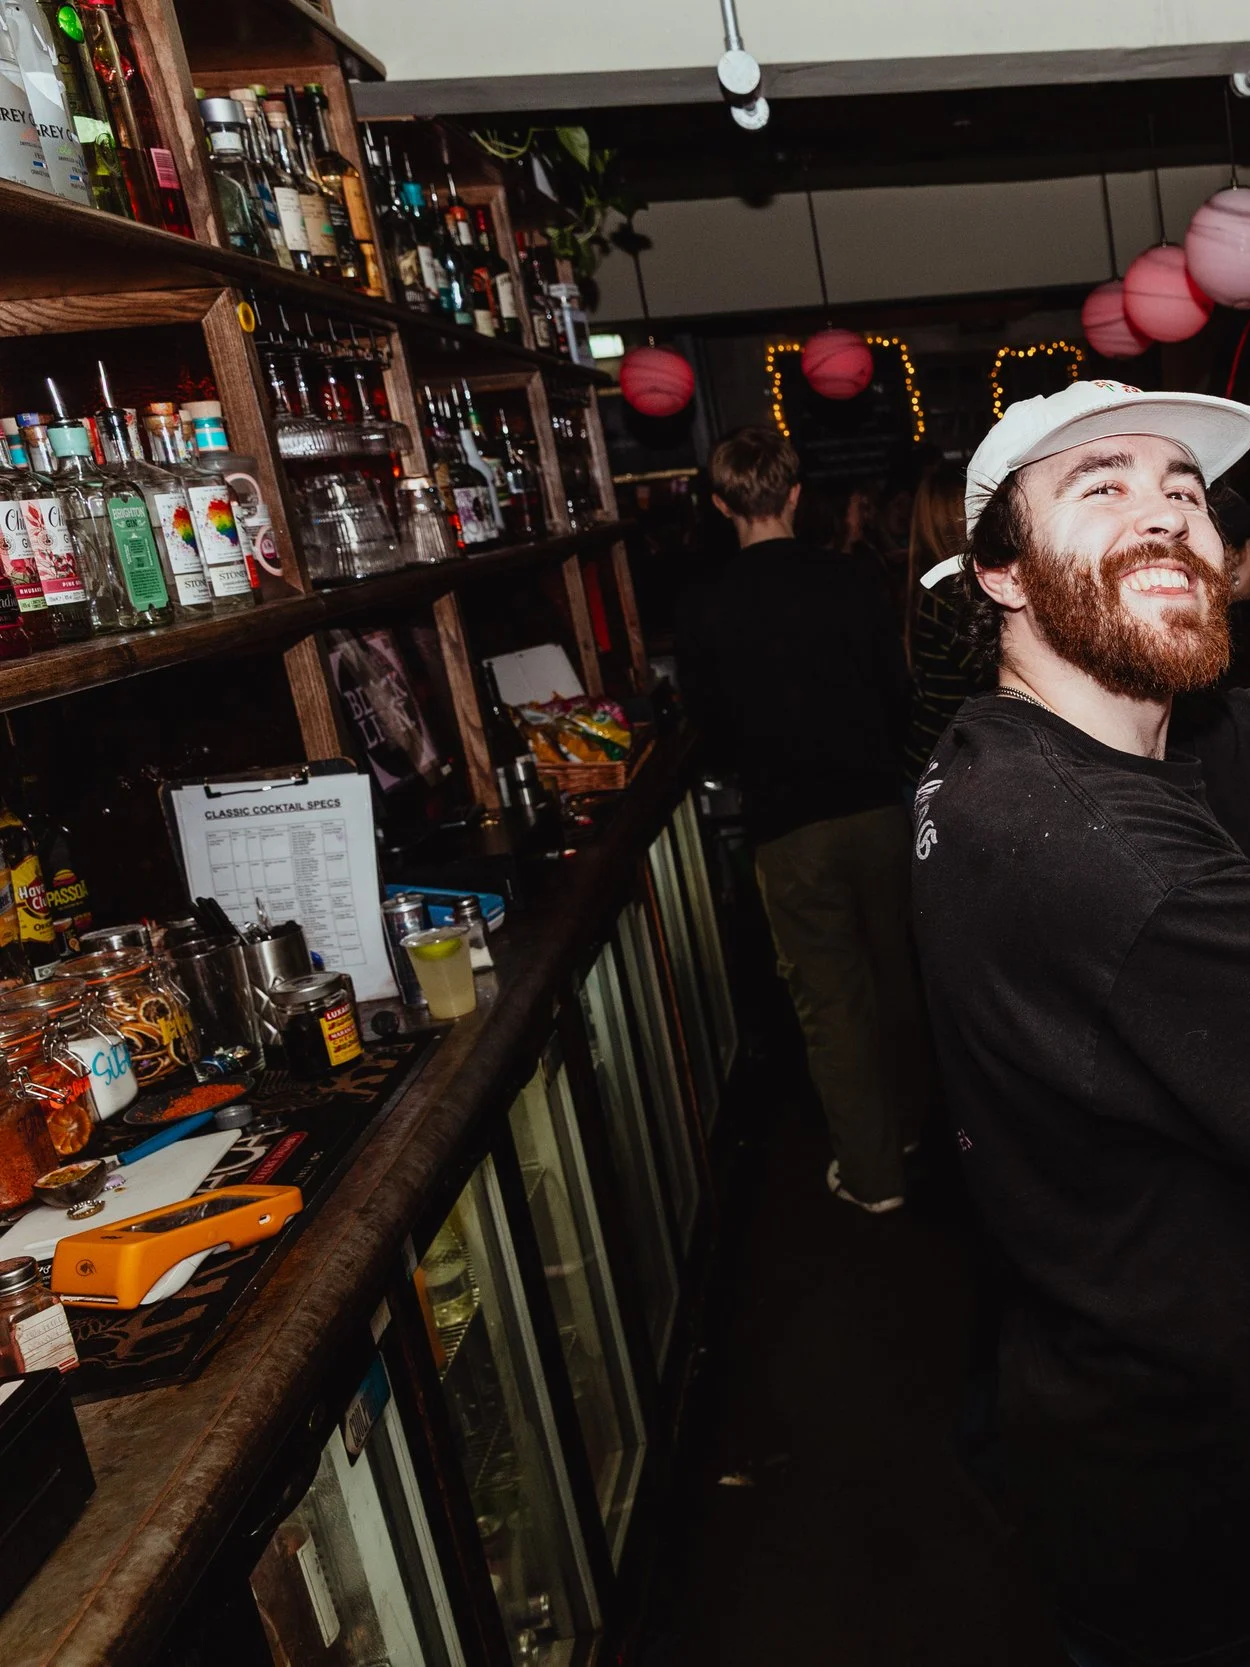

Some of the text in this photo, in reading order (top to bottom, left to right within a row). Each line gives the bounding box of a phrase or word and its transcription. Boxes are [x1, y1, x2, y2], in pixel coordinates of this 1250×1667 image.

[0, 107, 26, 124] REY
[112, 507, 146, 520] BRIGHTON
[125, 518, 139, 529] GIN
[205, 798, 341, 819] CLASSIC COCKTAIL SPECS
